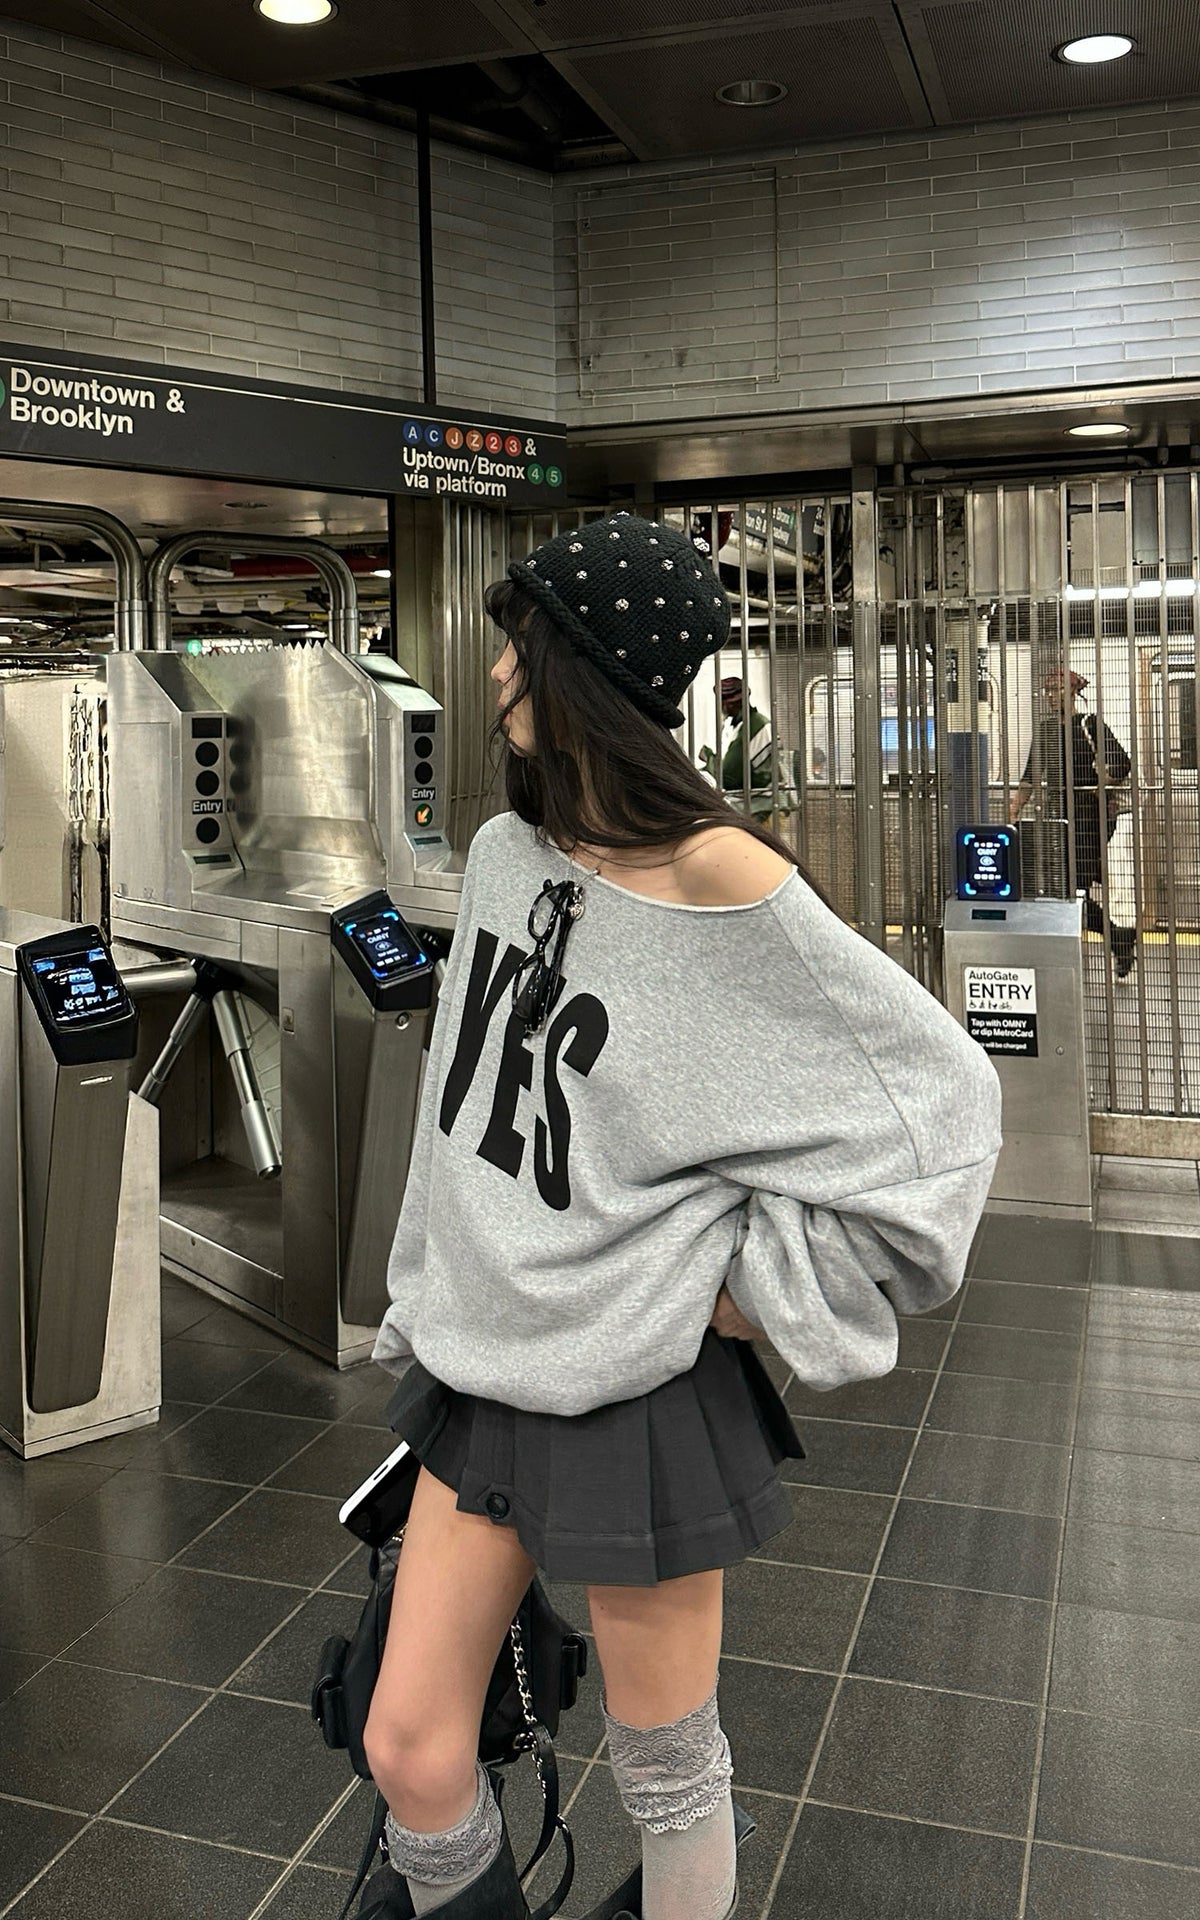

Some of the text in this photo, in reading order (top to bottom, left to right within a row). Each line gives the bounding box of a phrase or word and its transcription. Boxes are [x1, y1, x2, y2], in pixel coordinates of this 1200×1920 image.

[11, 367, 186, 413] Downtown &
[11, 396, 134, 436] Brooklyn
[408, 426, 537, 456] A C J Z 2 3 &
[403, 447, 525, 480] Uptown/Bronx
[403, 470, 507, 497] via platform
[412, 788, 435, 800] Entry
[193, 801, 222, 814] Entry
[969, 970, 1019, 981] AutoGate
[969, 983, 1032, 1000] ENTRY
[971, 1018, 1027, 1028] Tap with OMNY
[980, 1028, 993, 1037] dip
[993, 1028, 1034, 1038] MetroCard
[439, 928, 609, 1211] YES
